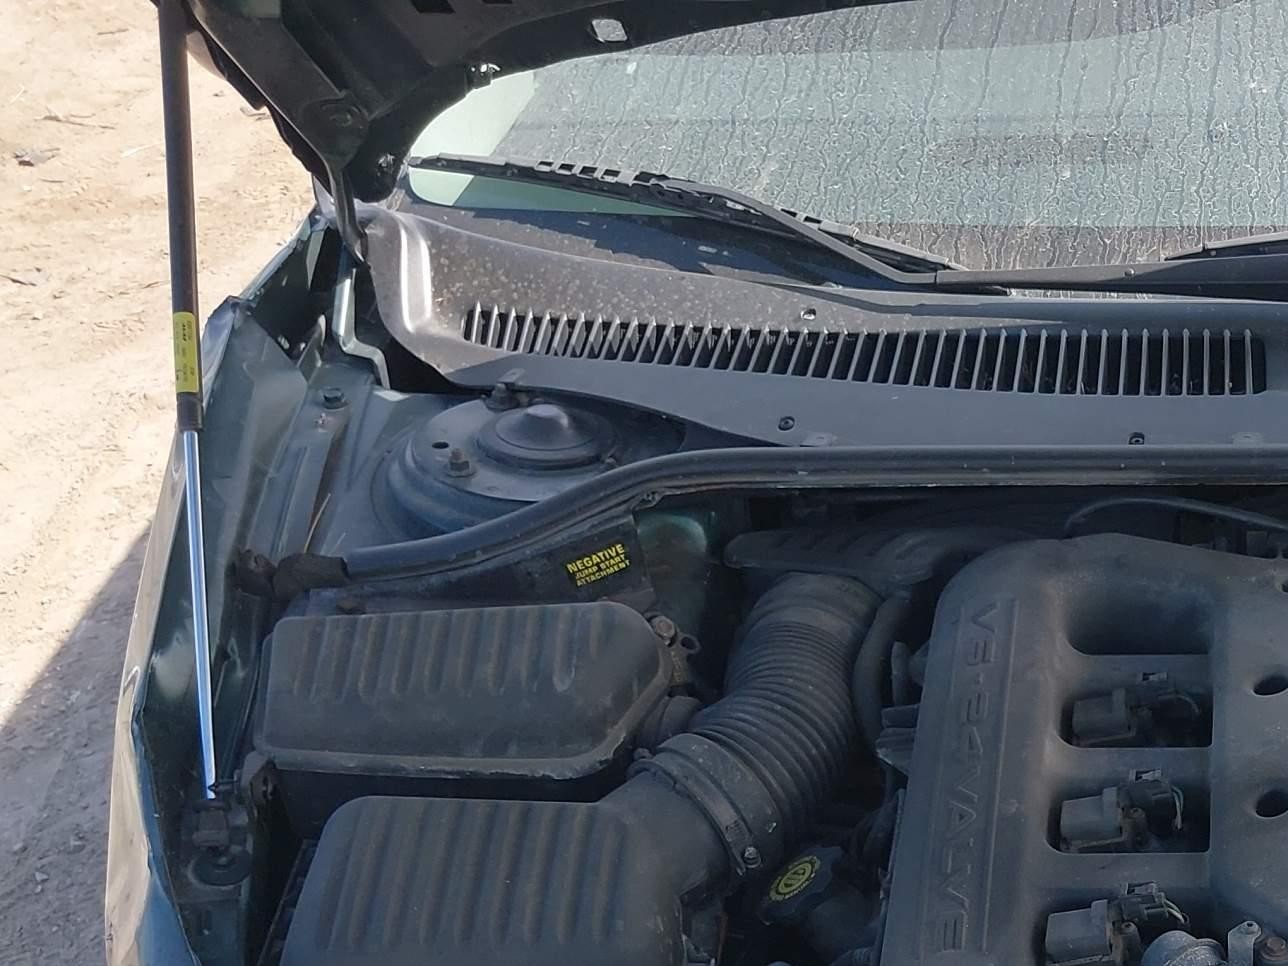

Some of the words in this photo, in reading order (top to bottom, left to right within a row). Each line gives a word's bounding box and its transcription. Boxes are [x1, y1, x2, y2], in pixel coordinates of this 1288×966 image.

[566, 544, 625, 573] NEGATIVE
[576, 565, 599, 579] JUMP
[600, 554, 625, 570] START
[576, 560, 630, 586] ATTACHMENT
